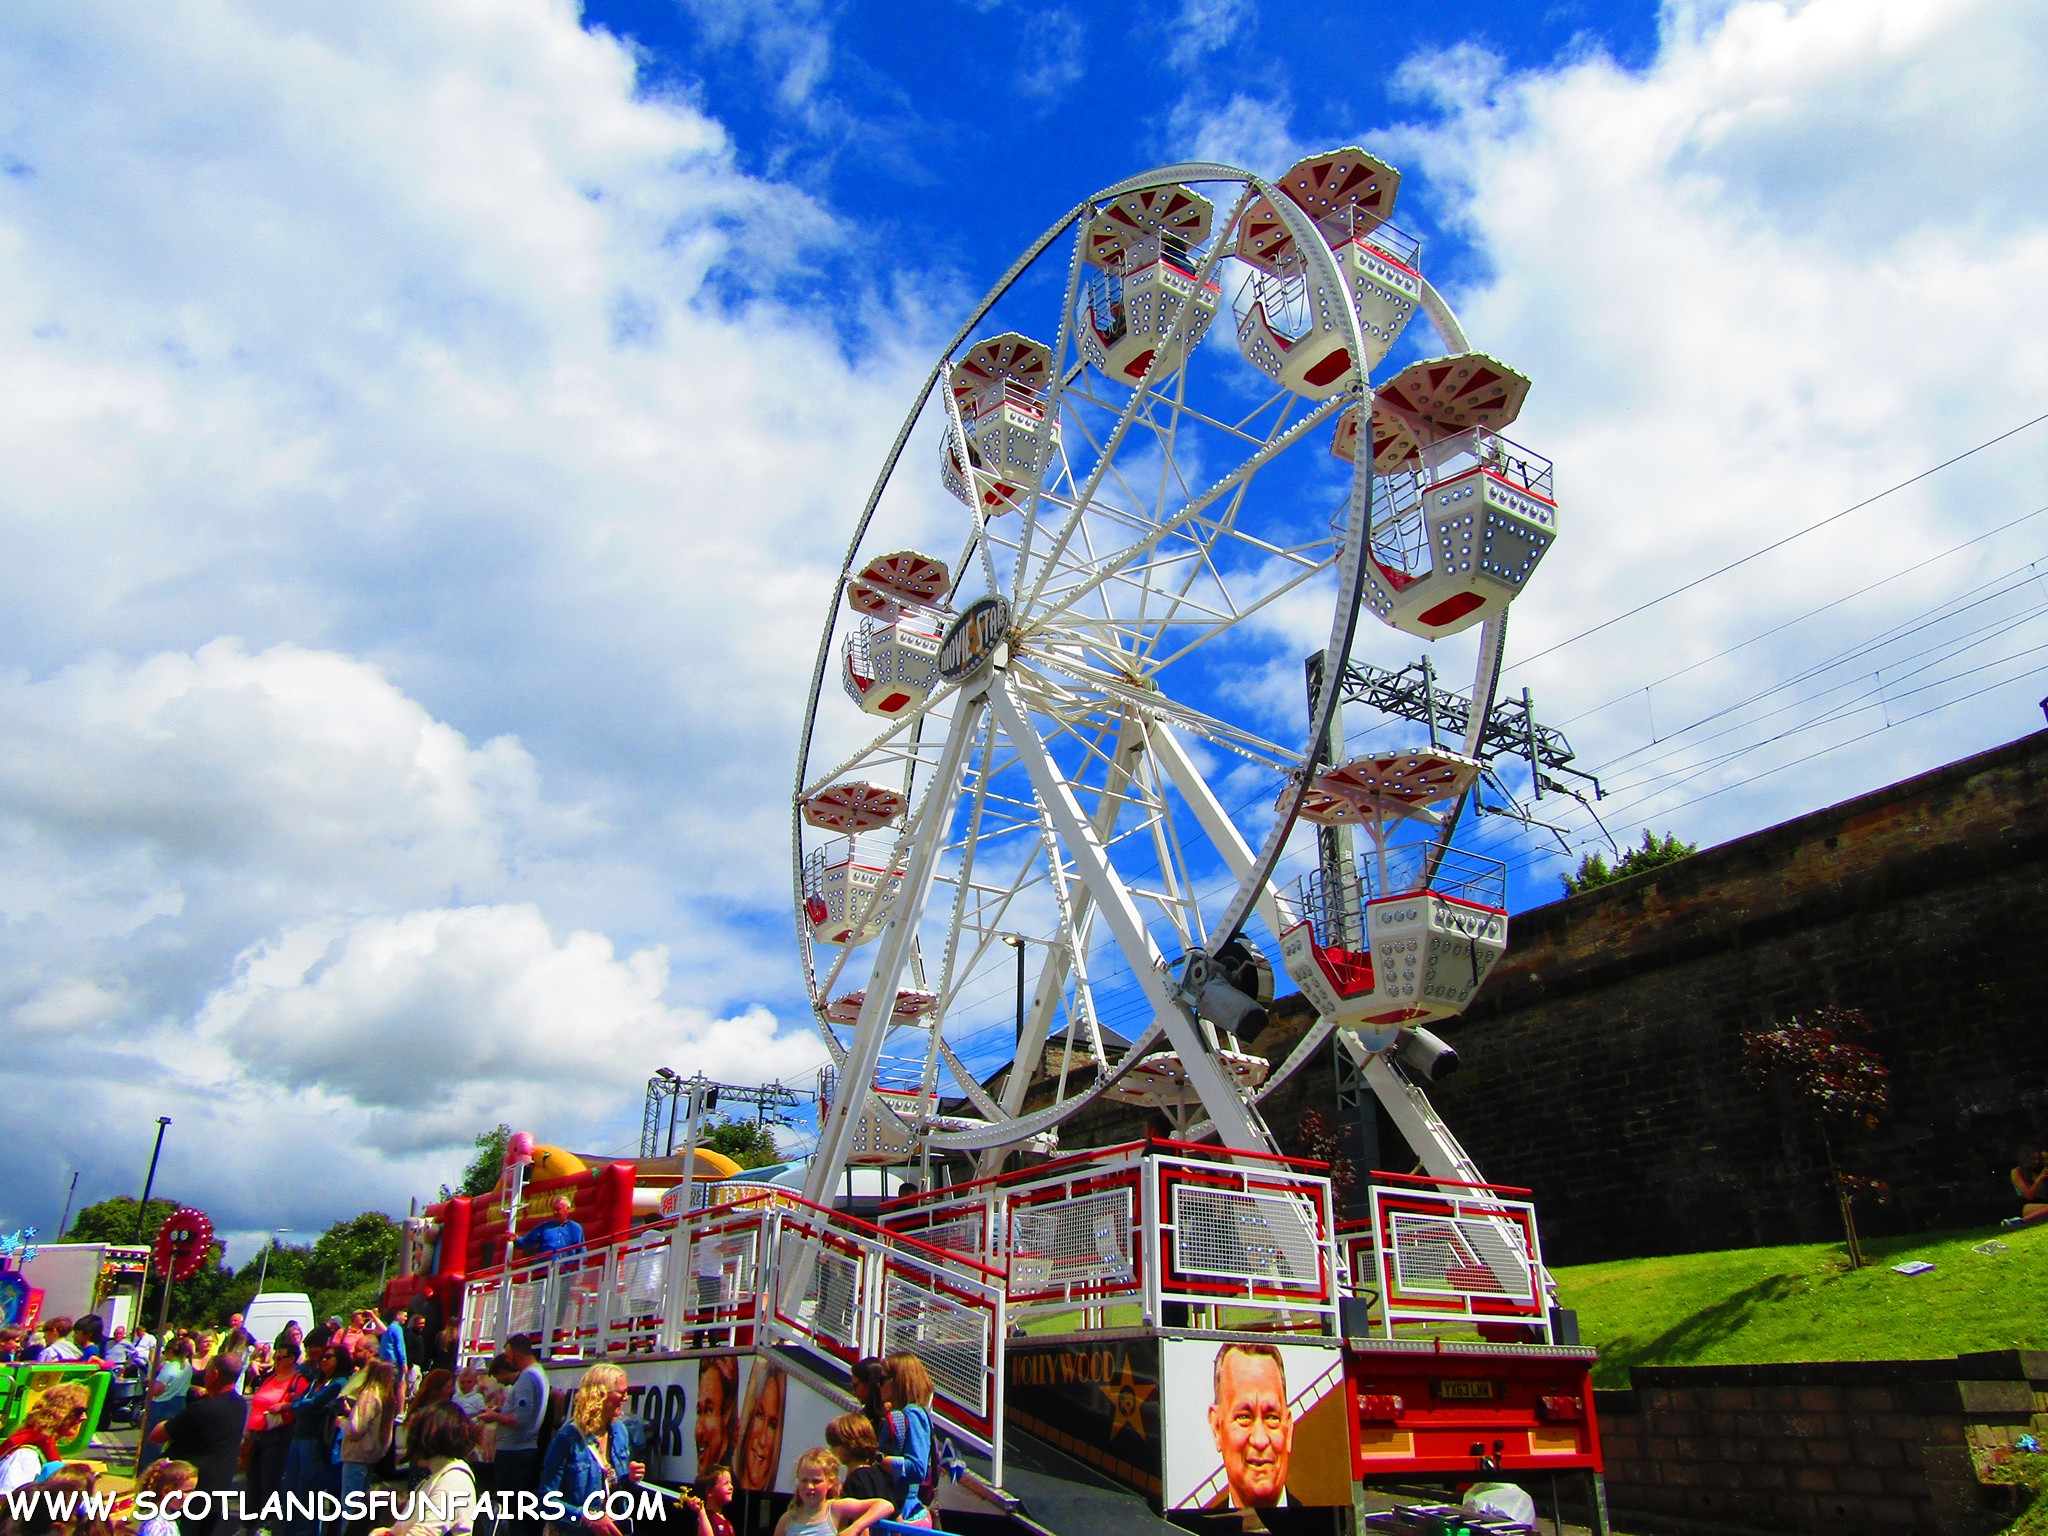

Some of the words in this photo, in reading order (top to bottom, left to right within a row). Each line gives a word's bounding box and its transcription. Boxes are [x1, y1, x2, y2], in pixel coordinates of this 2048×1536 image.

[940, 618, 973, 672] MOVIE
[976, 600, 1006, 652] STAR
[1012, 1350, 1116, 1387] HOLLYWOOD
